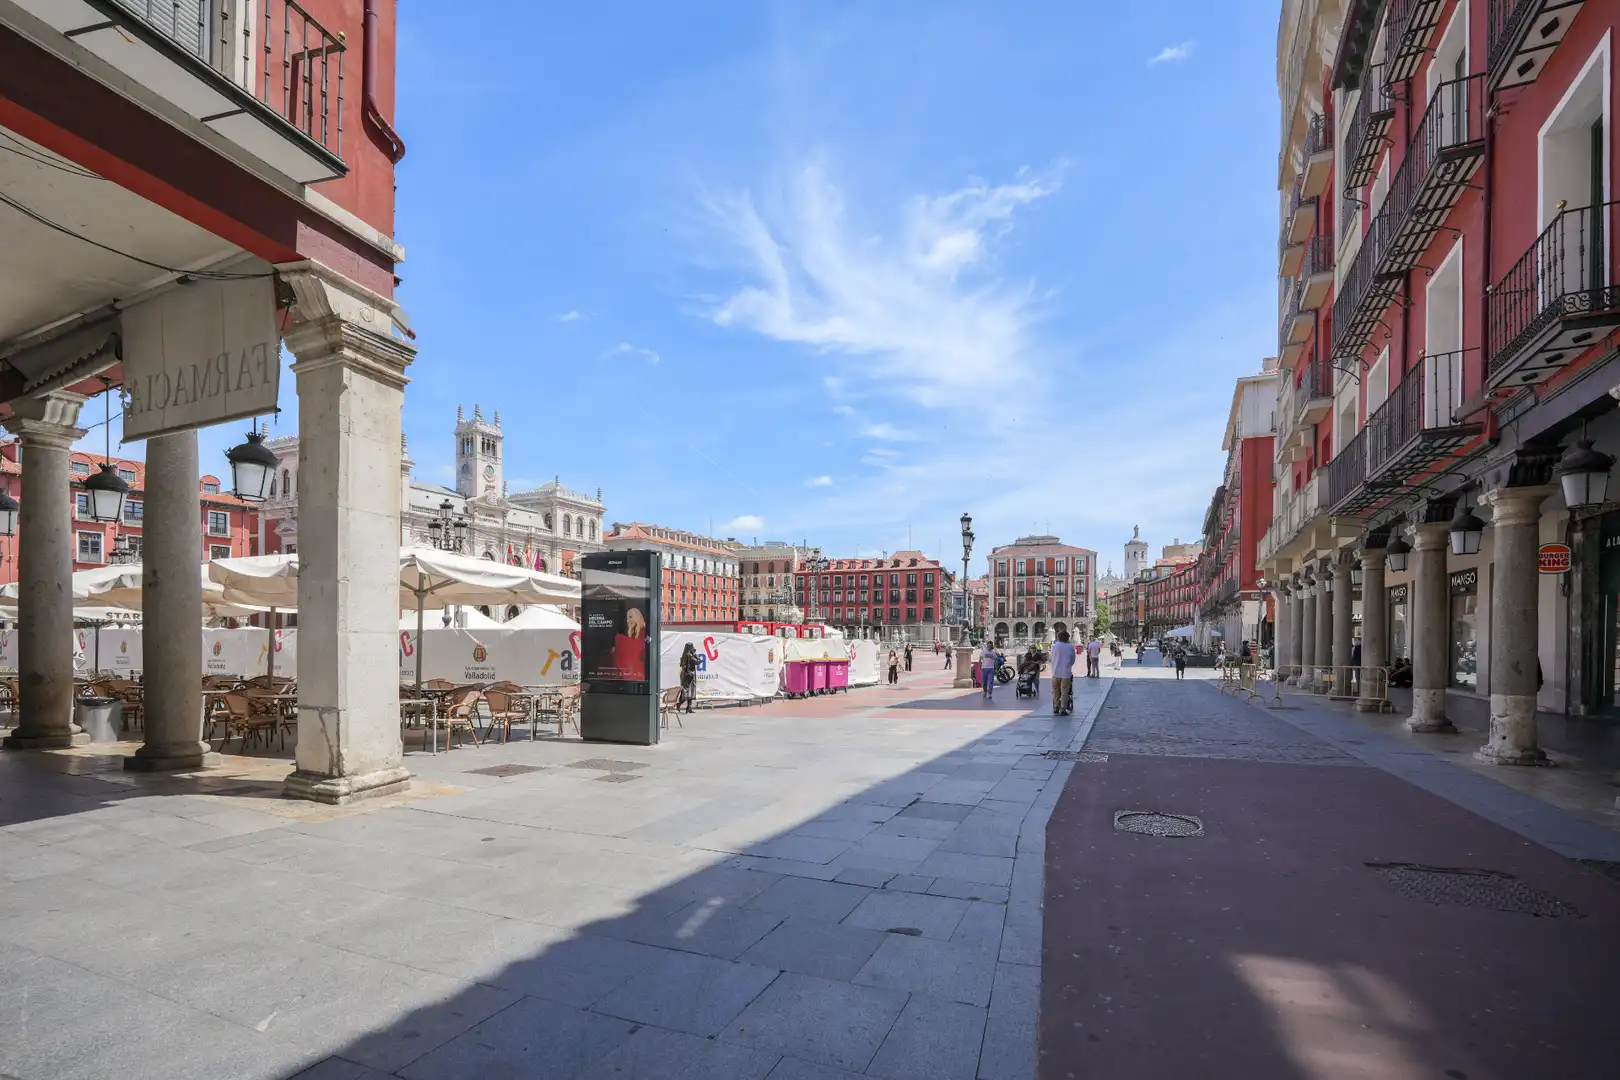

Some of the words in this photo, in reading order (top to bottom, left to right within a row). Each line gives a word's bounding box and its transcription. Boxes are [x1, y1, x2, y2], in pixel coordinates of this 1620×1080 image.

[1539, 559, 1569, 568] KING
[1451, 572, 1476, 587] MANGO
[1390, 587, 1407, 598] MANGO
[464, 671, 496, 679] Valladolid
